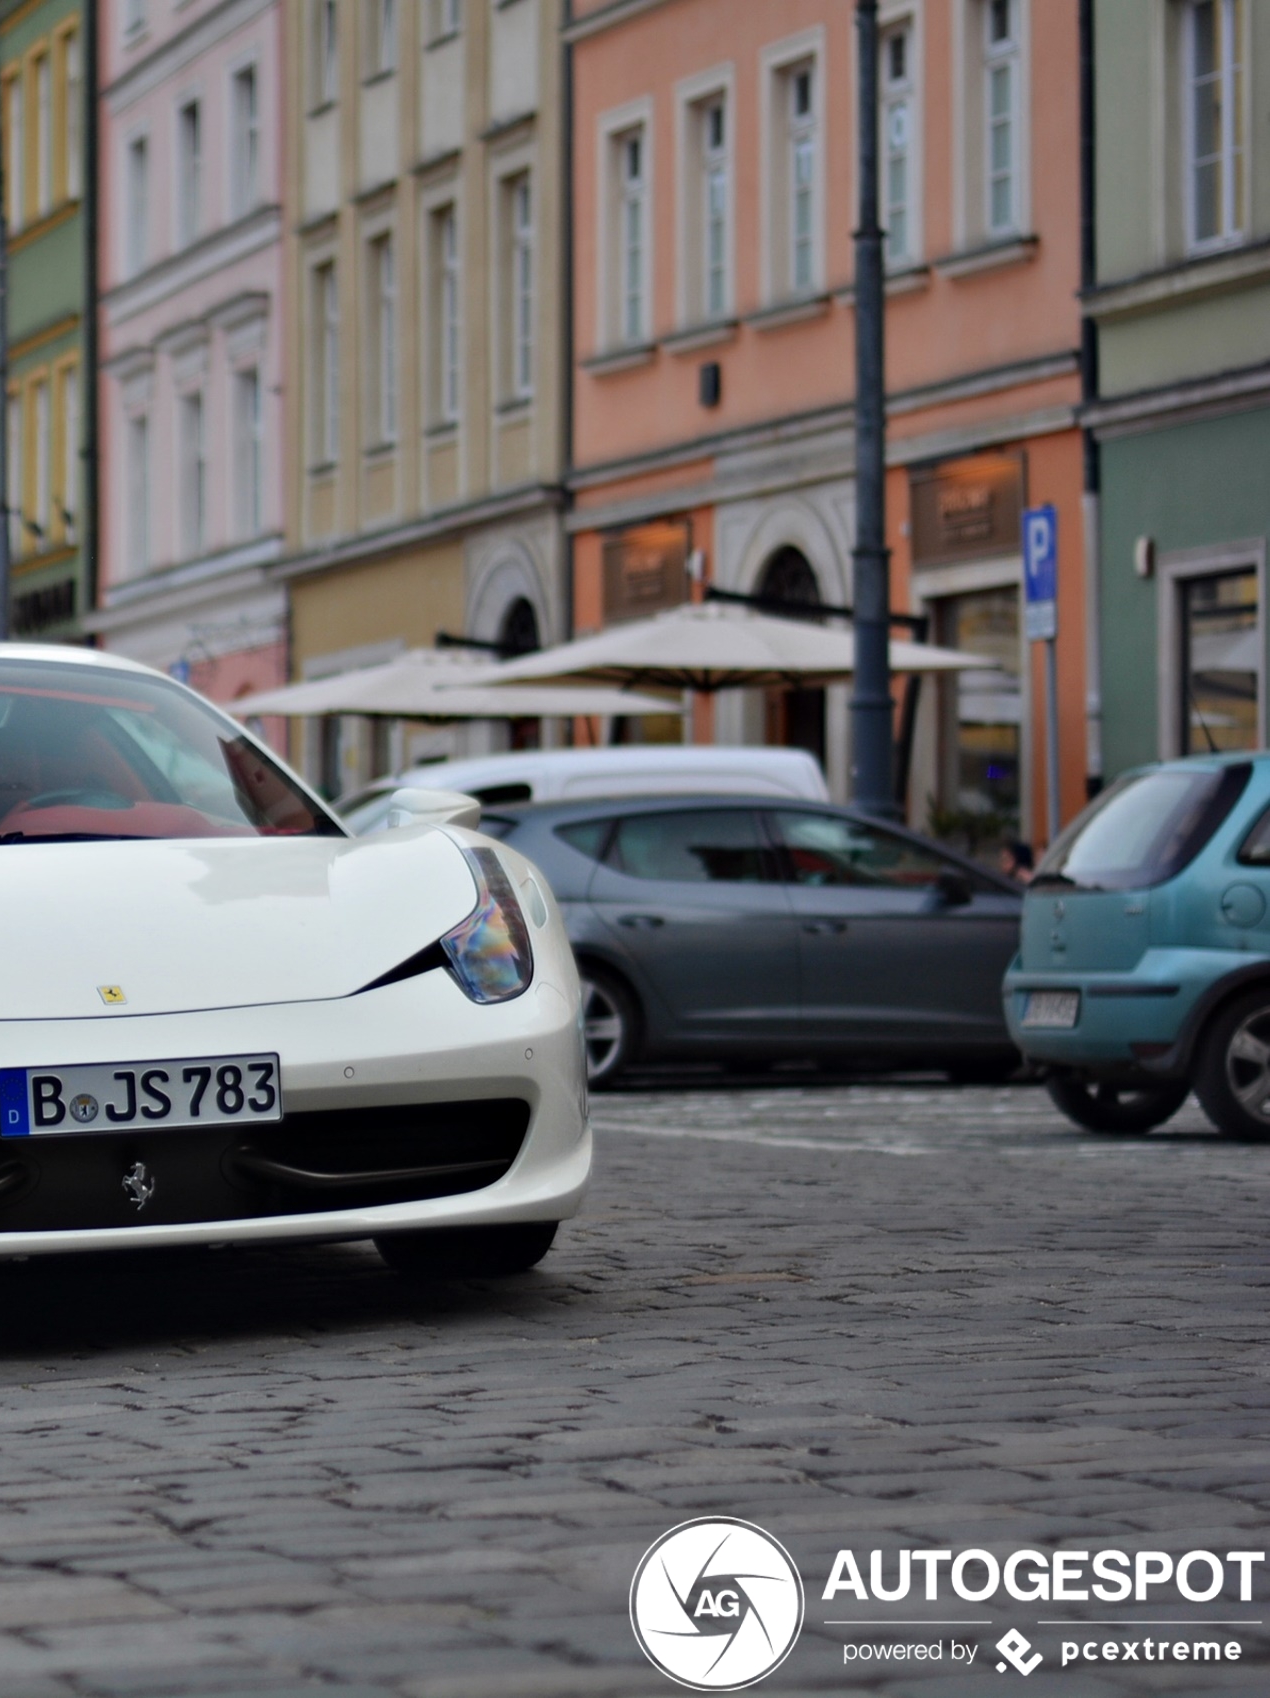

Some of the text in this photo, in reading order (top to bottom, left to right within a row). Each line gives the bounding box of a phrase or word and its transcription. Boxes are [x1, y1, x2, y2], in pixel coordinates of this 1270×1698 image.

[1030, 517, 1050, 577] P
[8, 1109, 20, 1124] D
[32, 1076, 66, 1126] B
